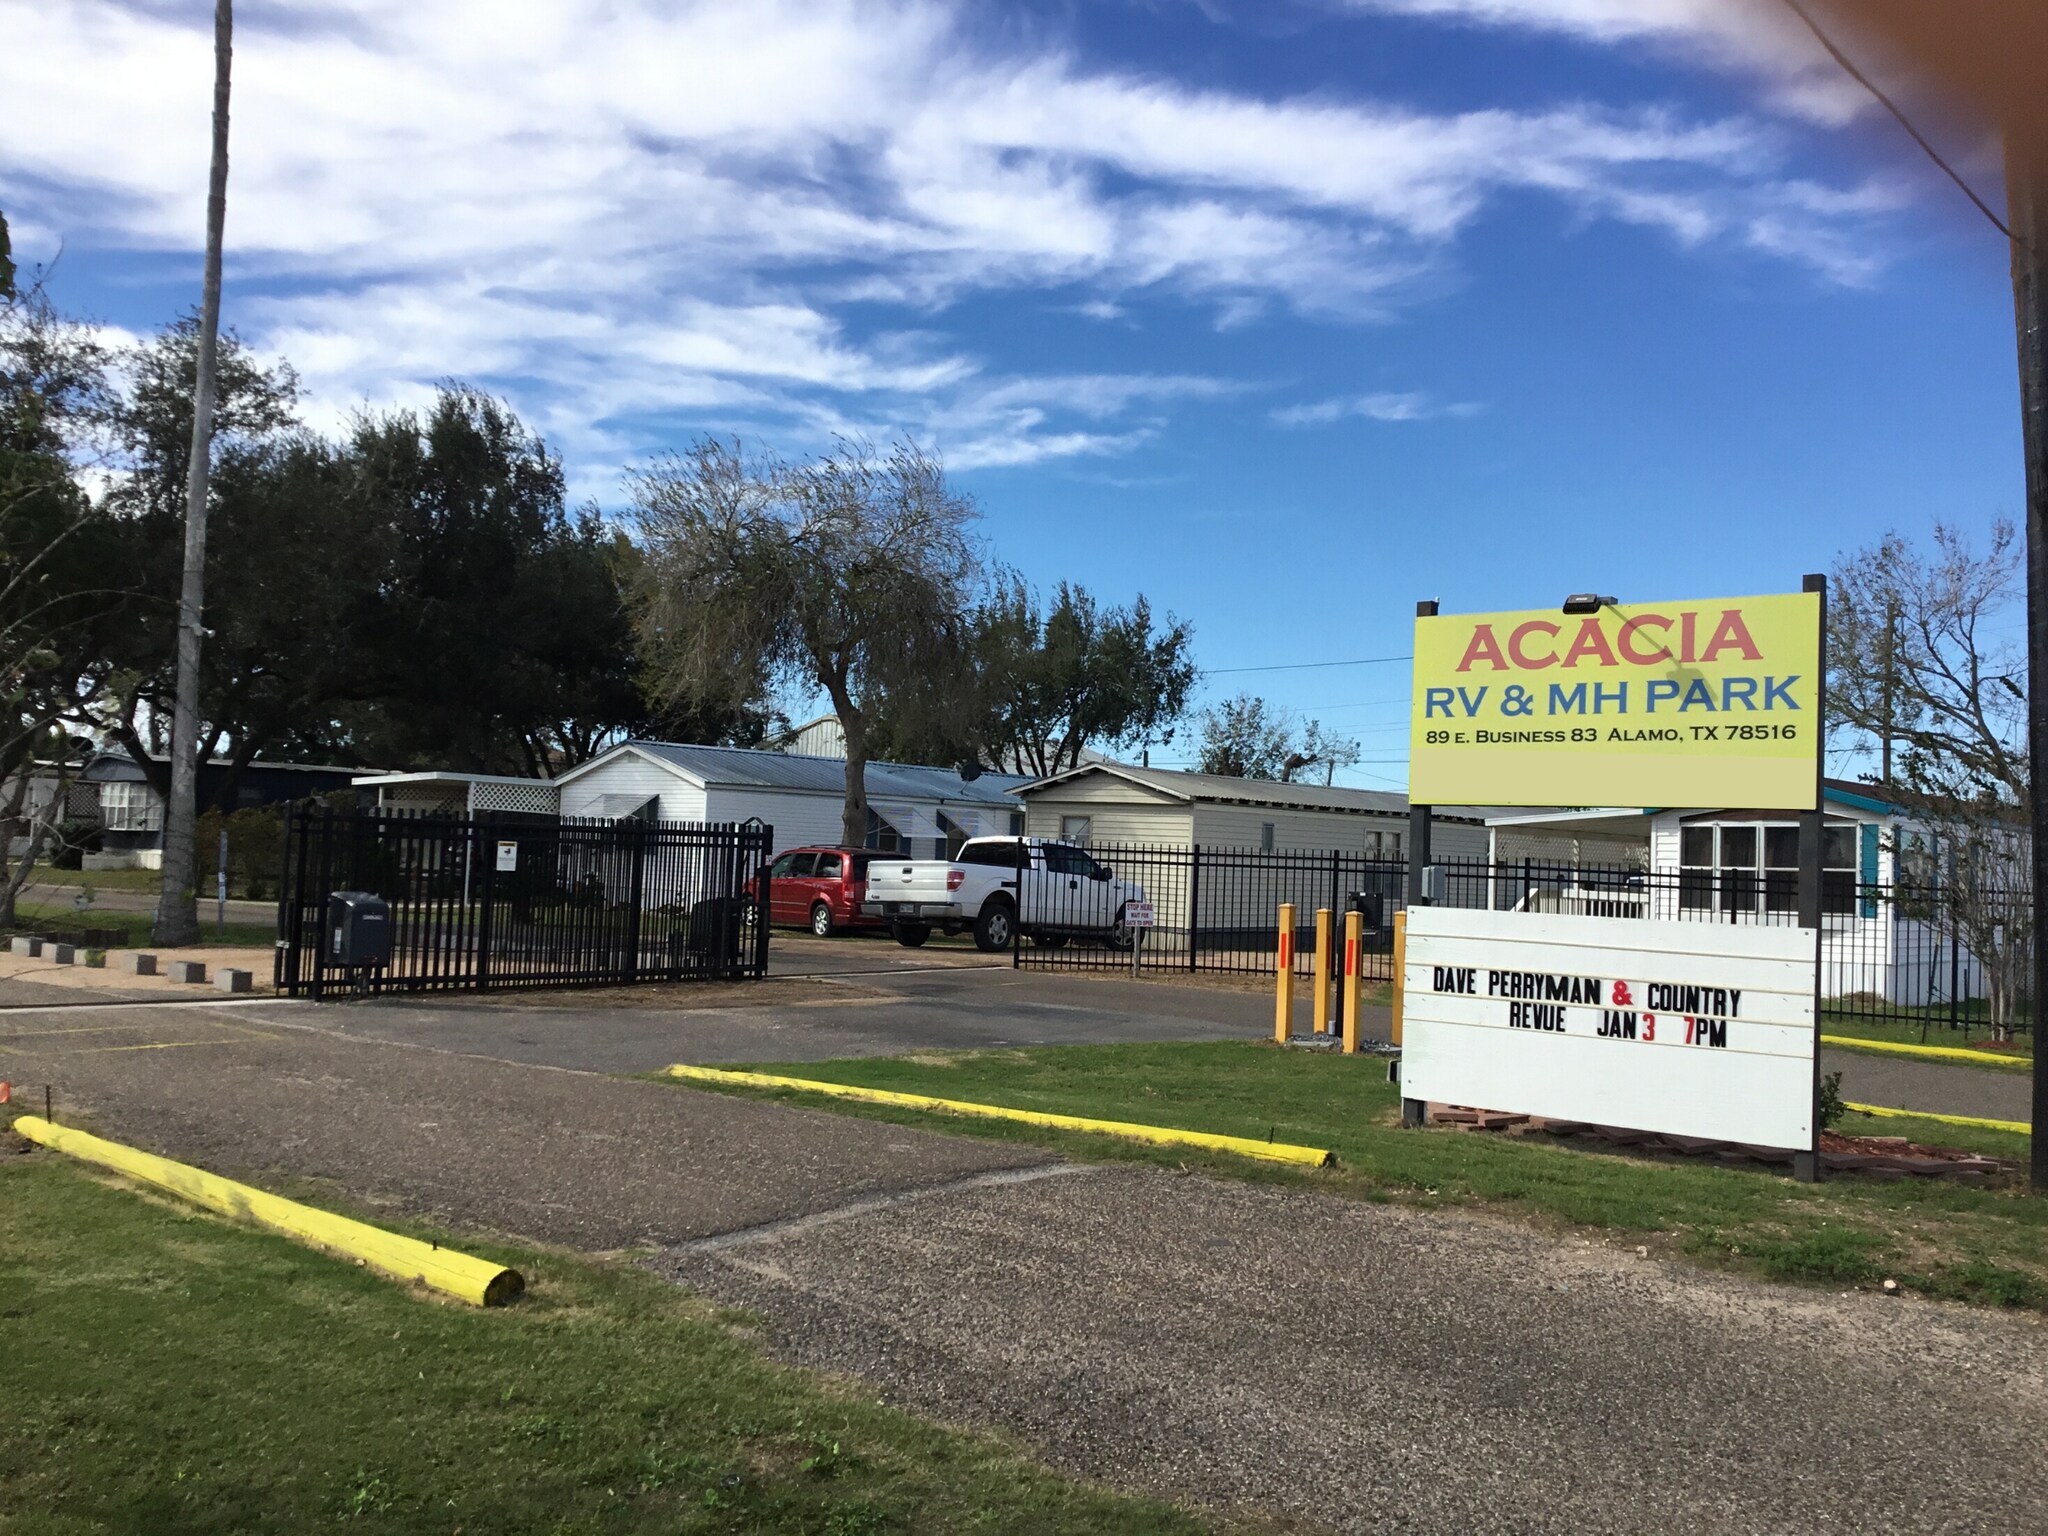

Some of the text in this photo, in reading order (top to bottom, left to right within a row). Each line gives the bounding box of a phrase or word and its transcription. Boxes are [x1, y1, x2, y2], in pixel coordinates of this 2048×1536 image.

[1456, 610, 1762, 672] ACACIA
[1425, 675, 1802, 718] RV & MH PARK
[1426, 730, 1450, 744] 89
[1455, 732, 1470, 744] E.
[1571, 728, 1598, 742] 83
[1690, 726, 1719, 741] TX
[1725, 725, 1797, 740] 78516
[1433, 965, 1742, 1018] DAVE PERRYMAN & COUNTRY
[1509, 1001, 1728, 1048] REVUE JAN 3 7PM
